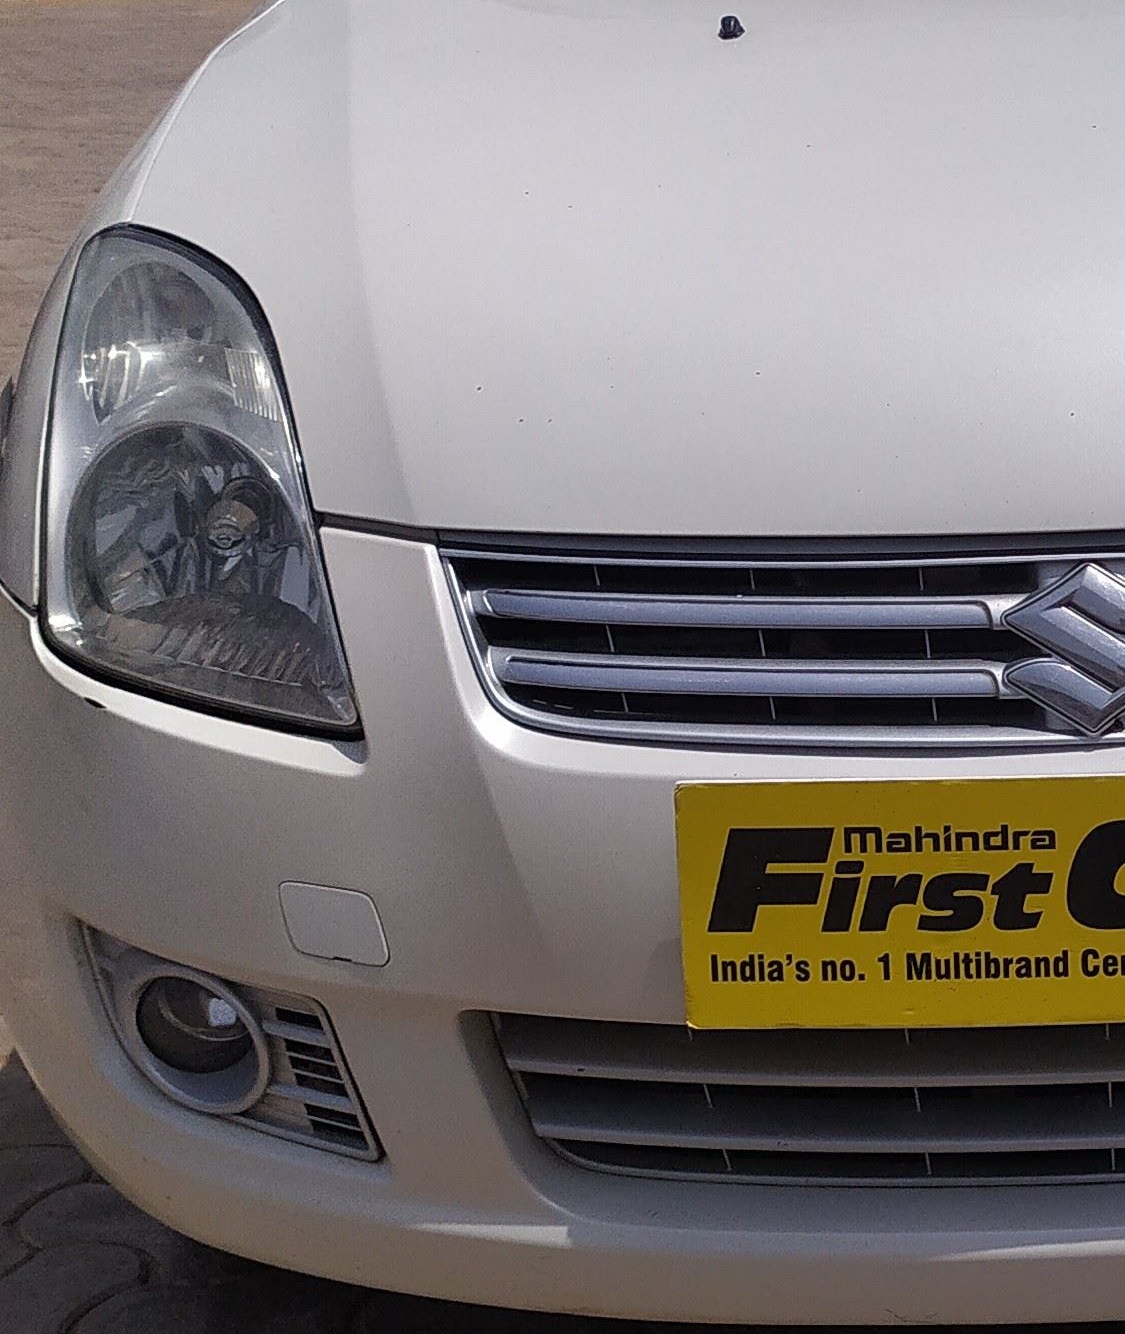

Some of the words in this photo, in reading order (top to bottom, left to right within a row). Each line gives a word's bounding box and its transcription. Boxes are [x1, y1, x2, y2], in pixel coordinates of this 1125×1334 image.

[843, 824, 1056, 853] Mahindra
[707, 827, 1055, 932] First
[710, 953, 810, 982] India's
[822, 957, 866, 981] no.
[877, 953, 891, 980] 1
[906, 949, 1069, 981] Multibrand
